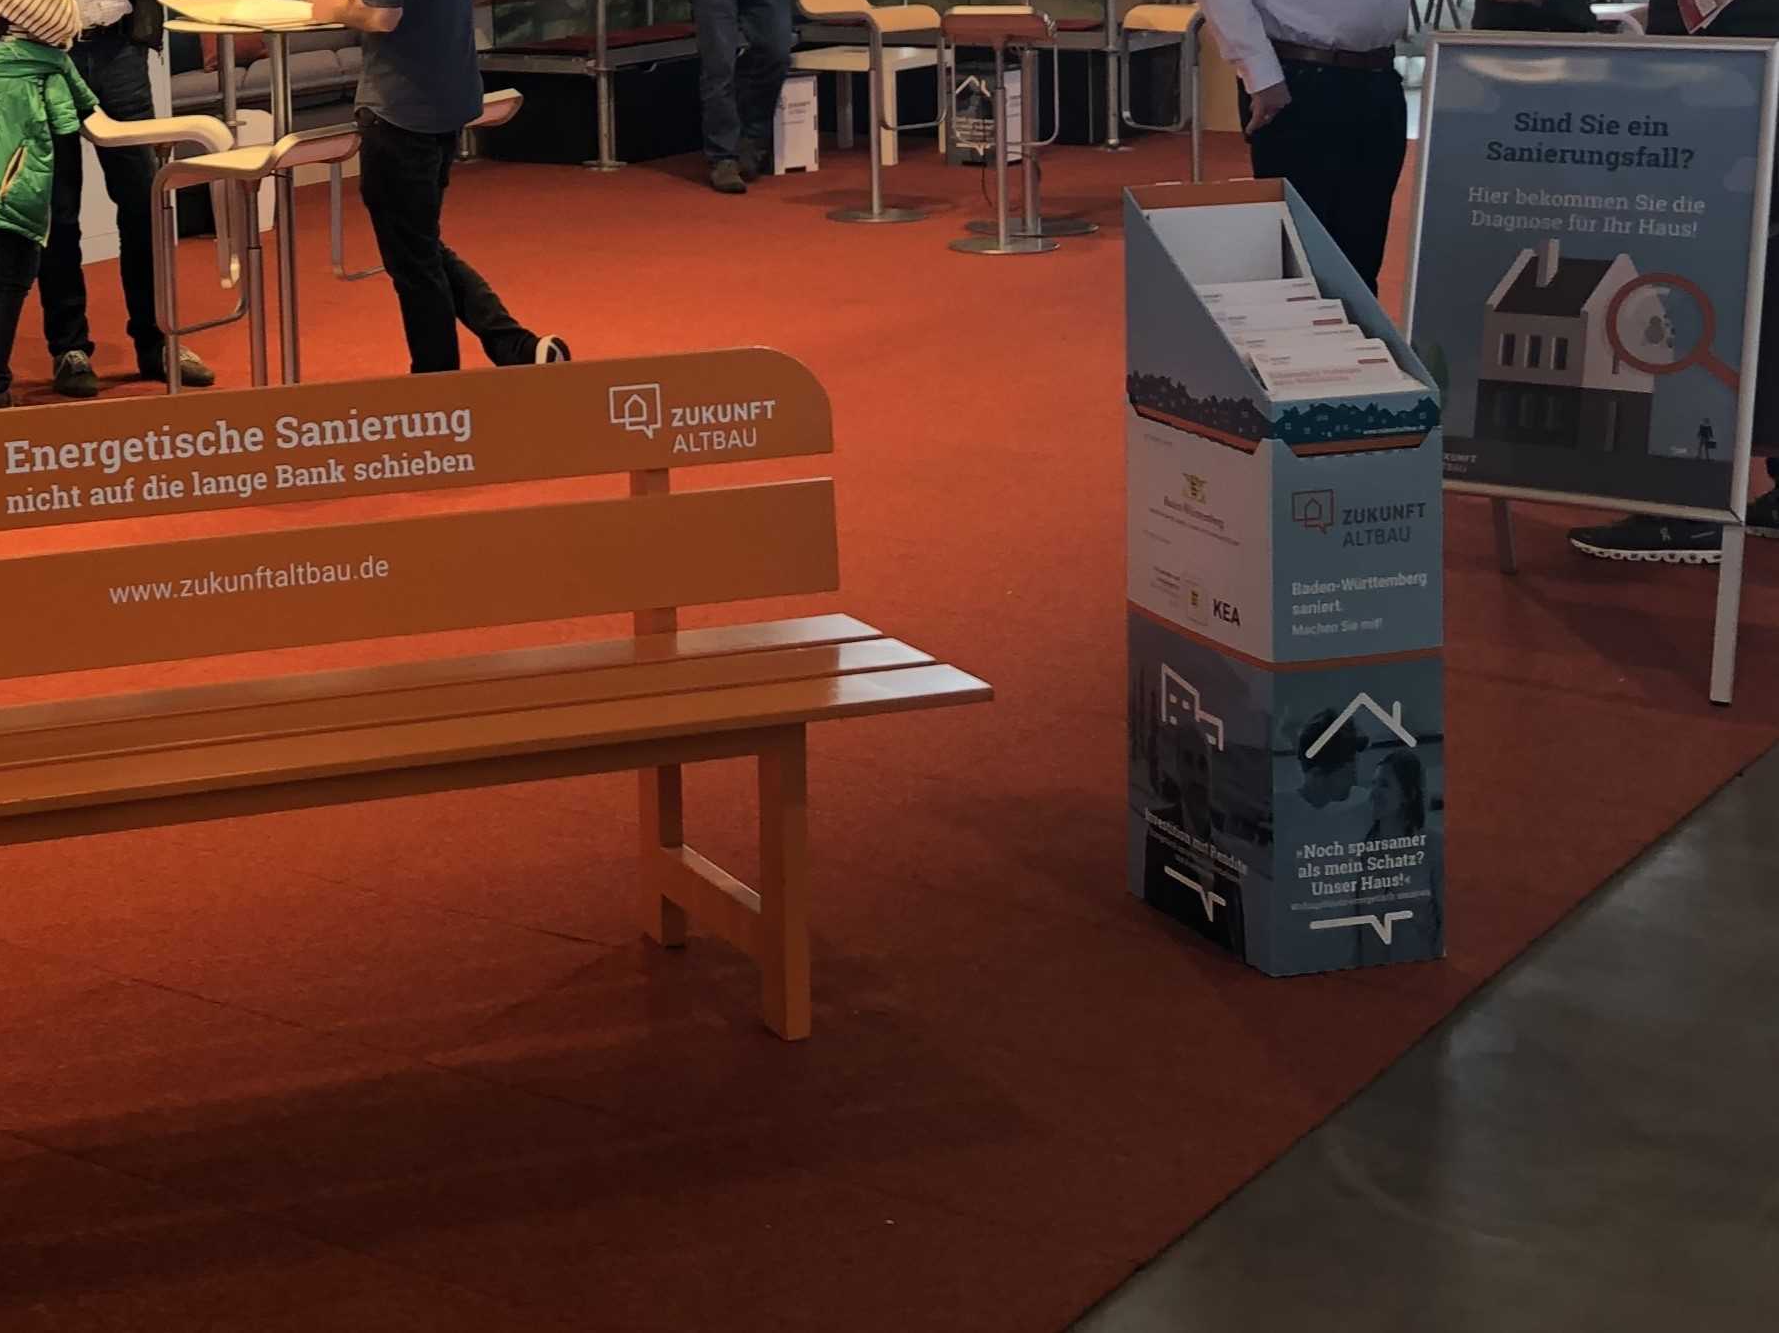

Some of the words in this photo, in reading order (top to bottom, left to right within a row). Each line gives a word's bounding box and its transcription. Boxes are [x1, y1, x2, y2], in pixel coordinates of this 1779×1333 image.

[1515, 112, 1571, 133] Sind
[1580, 114, 1620, 136] Sie
[1628, 115, 1669, 137] ein
[1486, 141, 1694, 171] Sanierungsfall?
[1468, 186, 1509, 204] Hier
[1516, 188, 1628, 210] bekommen
[1635, 194, 1667, 212] Sie
[1672, 195, 1705, 214] die
[1470, 210, 1562, 234] Diagnose
[1603, 217, 1630, 235] Ihr
[1639, 218, 1698, 237] Haus!
[671, 400, 776, 428] ZUKUNFT
[4, 419, 264, 473] Energetische
[275, 407, 472, 449] Sanierung
[673, 427, 757, 454] ALTBAU
[6, 484, 81, 515] nicht
[89, 476, 137, 507] auf
[143, 472, 184, 503] die
[192, 469, 267, 498] lange
[275, 459, 346, 489] Bank
[354, 451, 474, 482] schieben
[1342, 502, 1427, 525] ZUKUNFT
[1342, 526, 1411, 547] ALTBAU
[109, 555, 389, 605] www.zukunftaltbau.de
[1291, 572, 1428, 596] Baden-Württemberg
[1213, 598, 1240, 627] KEA
[1292, 623, 1338, 635] Machen
[1341, 620, 1358, 632] Sie
[1348, 834, 1427, 856] sparsamer
[1298, 863, 1320, 879] als
[1324, 861, 1363, 877] mein
[1367, 851, 1424, 872] Schatz?
[1312, 879, 1356, 897] Unser
